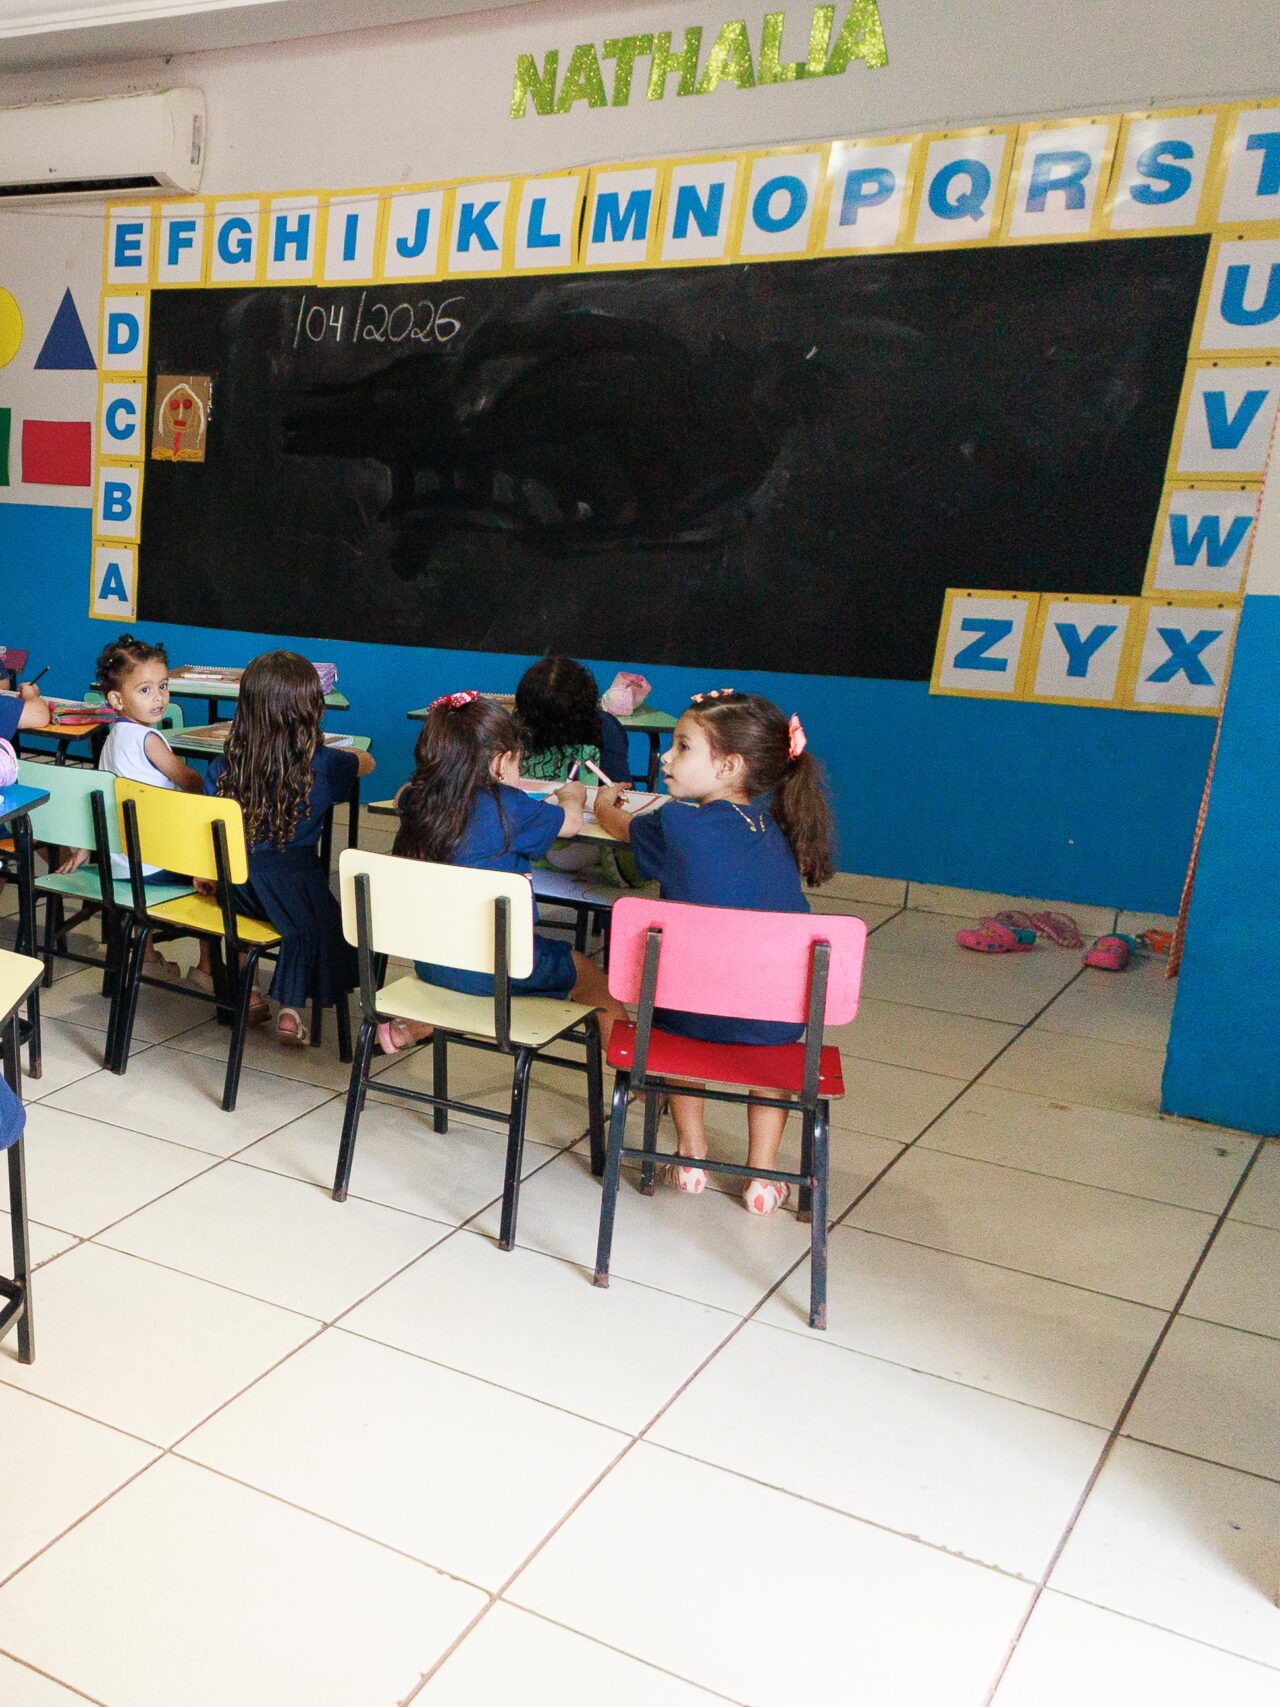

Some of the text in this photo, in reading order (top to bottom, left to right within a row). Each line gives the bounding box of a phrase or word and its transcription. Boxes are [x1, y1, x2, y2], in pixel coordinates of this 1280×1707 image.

[510, 0, 889, 118] NATHALIA
[114, 223, 144, 268] E
[167, 220, 197, 266] F
[217, 217, 253, 265] G
[273, 213, 311, 262] H
[342, 213, 359, 261] I
[396, 207, 431, 258] J
[456, 200, 501, 253] K
[526, 197, 561, 249] L
[591, 189, 652, 243] M
[672, 182, 725, 239] N
[752, 175, 808, 233] O
[839, 167, 895, 226] P
[928, 159, 991, 222] Q
[1025, 150, 1091, 214] R
[1130, 140, 1195, 205] S
[98, 312, 140, 602] D C B A
[1169, 262, 1280, 568] U V W
[953, 617, 1224, 687] Z Y X
